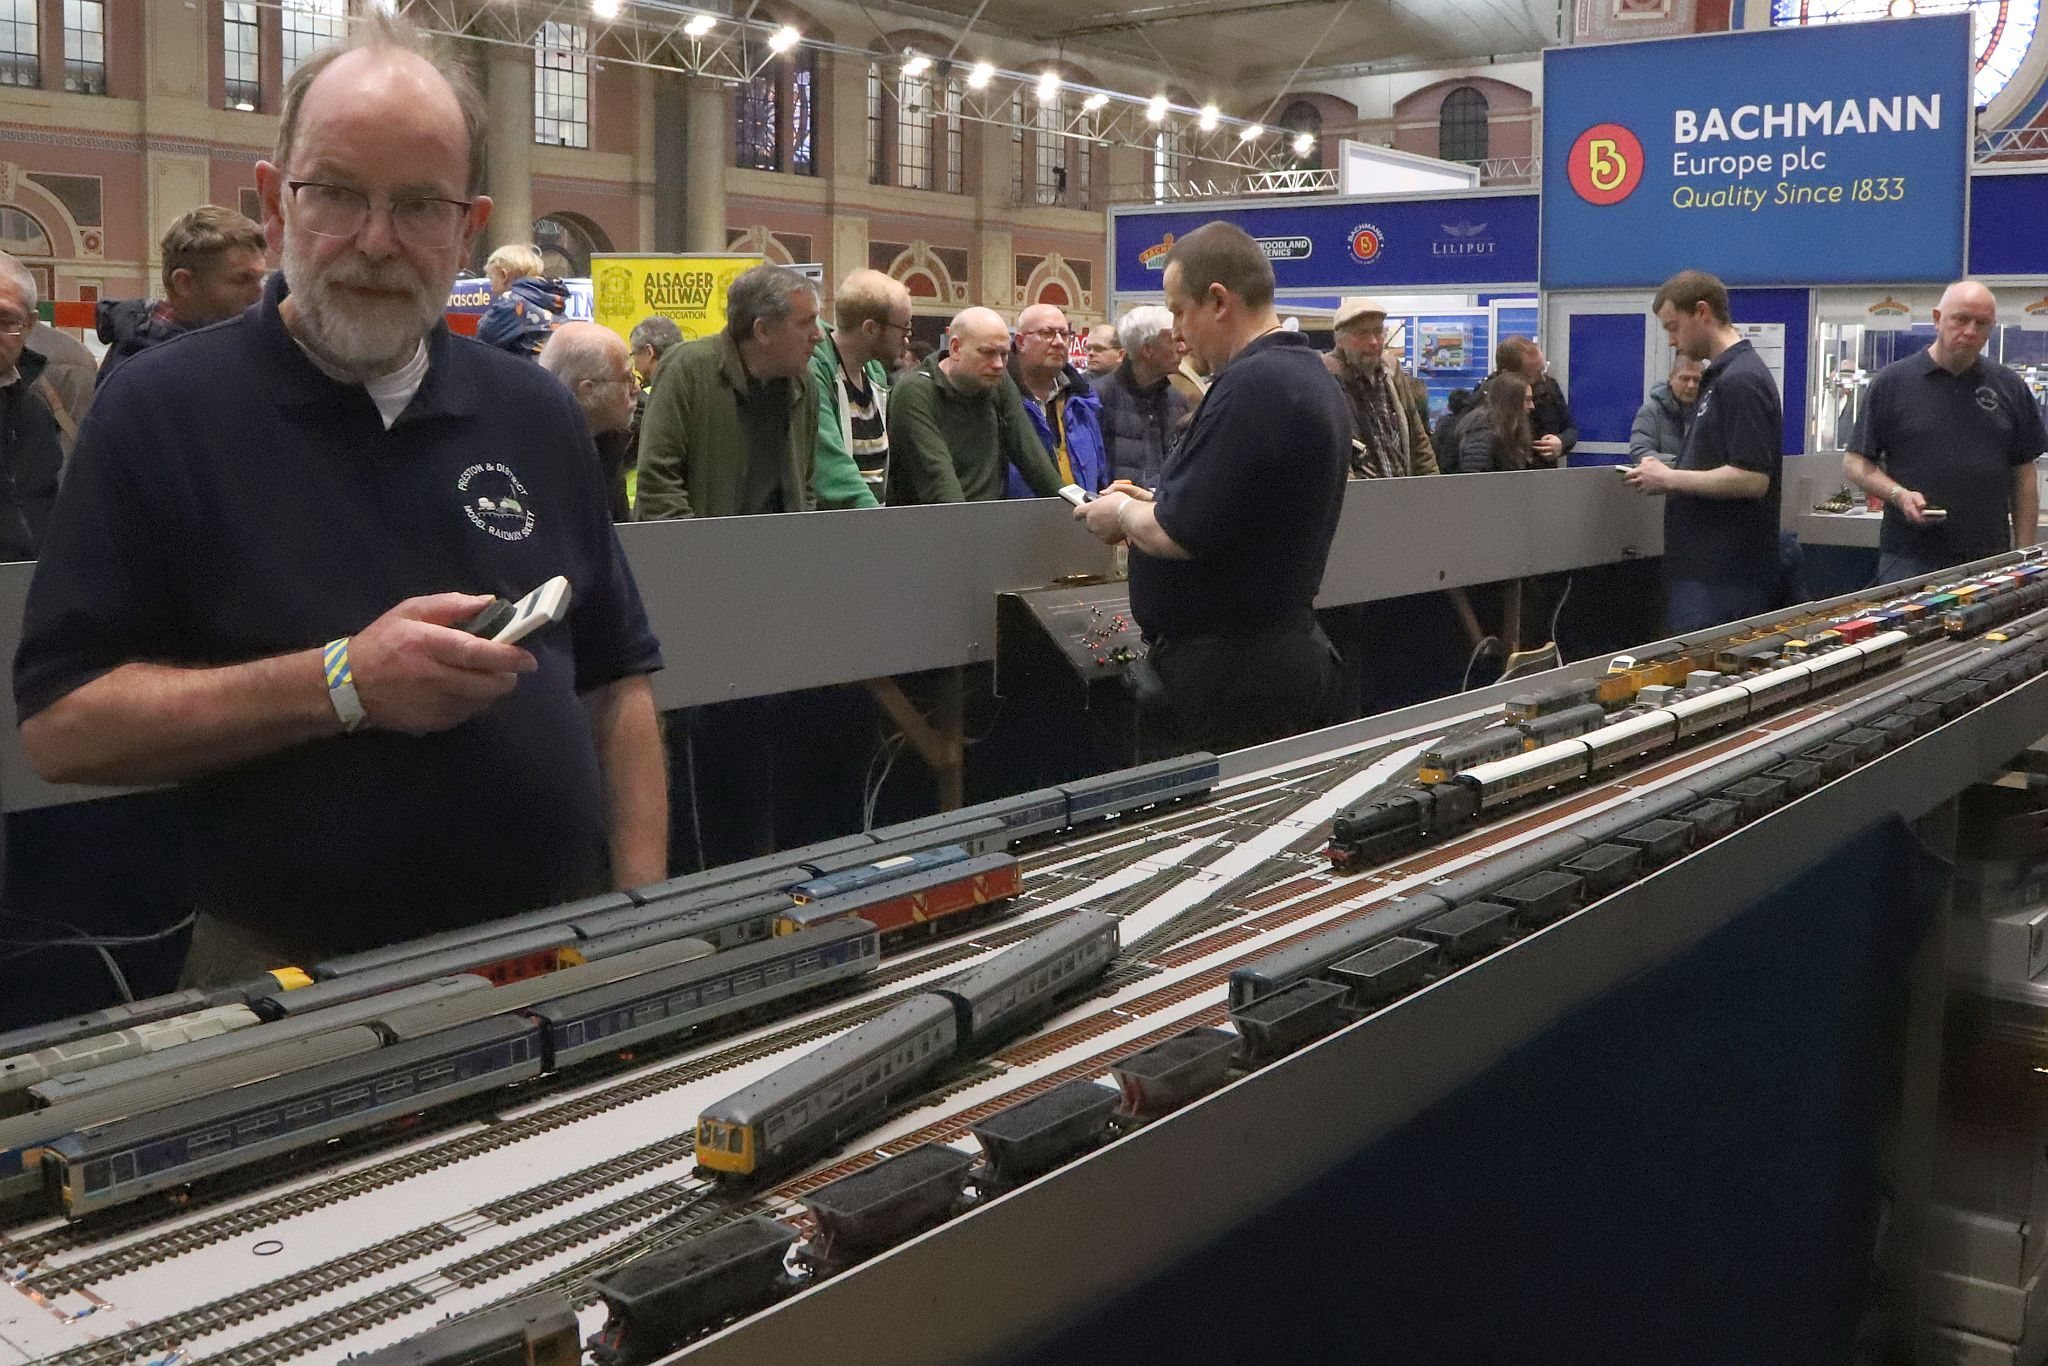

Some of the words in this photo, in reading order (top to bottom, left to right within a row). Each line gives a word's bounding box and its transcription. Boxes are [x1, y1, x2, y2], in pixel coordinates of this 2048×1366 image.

[1674, 93, 1941, 144] BACHMANN
[1673, 150, 1773, 180] Europe
[1782, 145, 1826, 178] plc
[1672, 184, 1768, 212] Quality
[1774, 181, 1843, 205] Since
[1851, 177, 1905, 202] 1833
[1433, 242, 1496, 255] LILIPUT
[644, 272, 714, 289] ALSAGER
[644, 287, 713, 305] RAILWAY
[457, 463, 485, 491] PRESTON
[485, 462, 495, 472] &
[496, 463, 528, 496] DISTRICT
[463, 504, 486, 531] MODEL
[488, 525, 523, 541] RAILWAY
